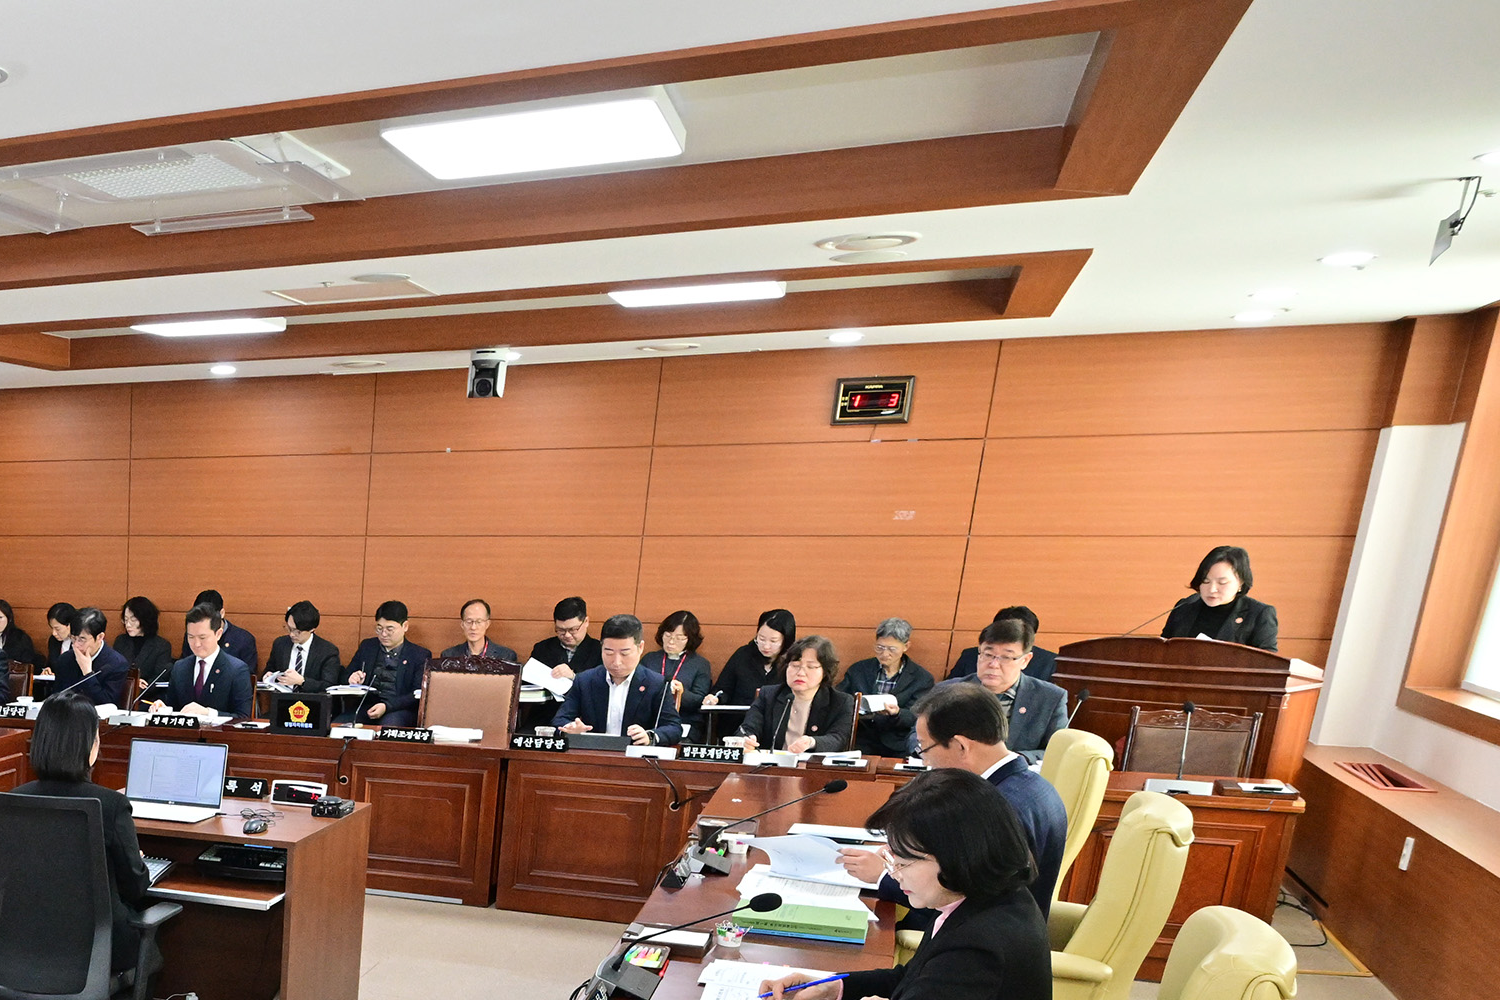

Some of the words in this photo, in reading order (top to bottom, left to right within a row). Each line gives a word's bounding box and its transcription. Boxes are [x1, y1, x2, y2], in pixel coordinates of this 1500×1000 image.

[152, 716, 195, 727] 정책기획관
[383, 730, 430, 741] 기획조정실장
[513, 736, 566, 750] 예산담당관
[683, 747, 741, 760] 법무통계담당관
